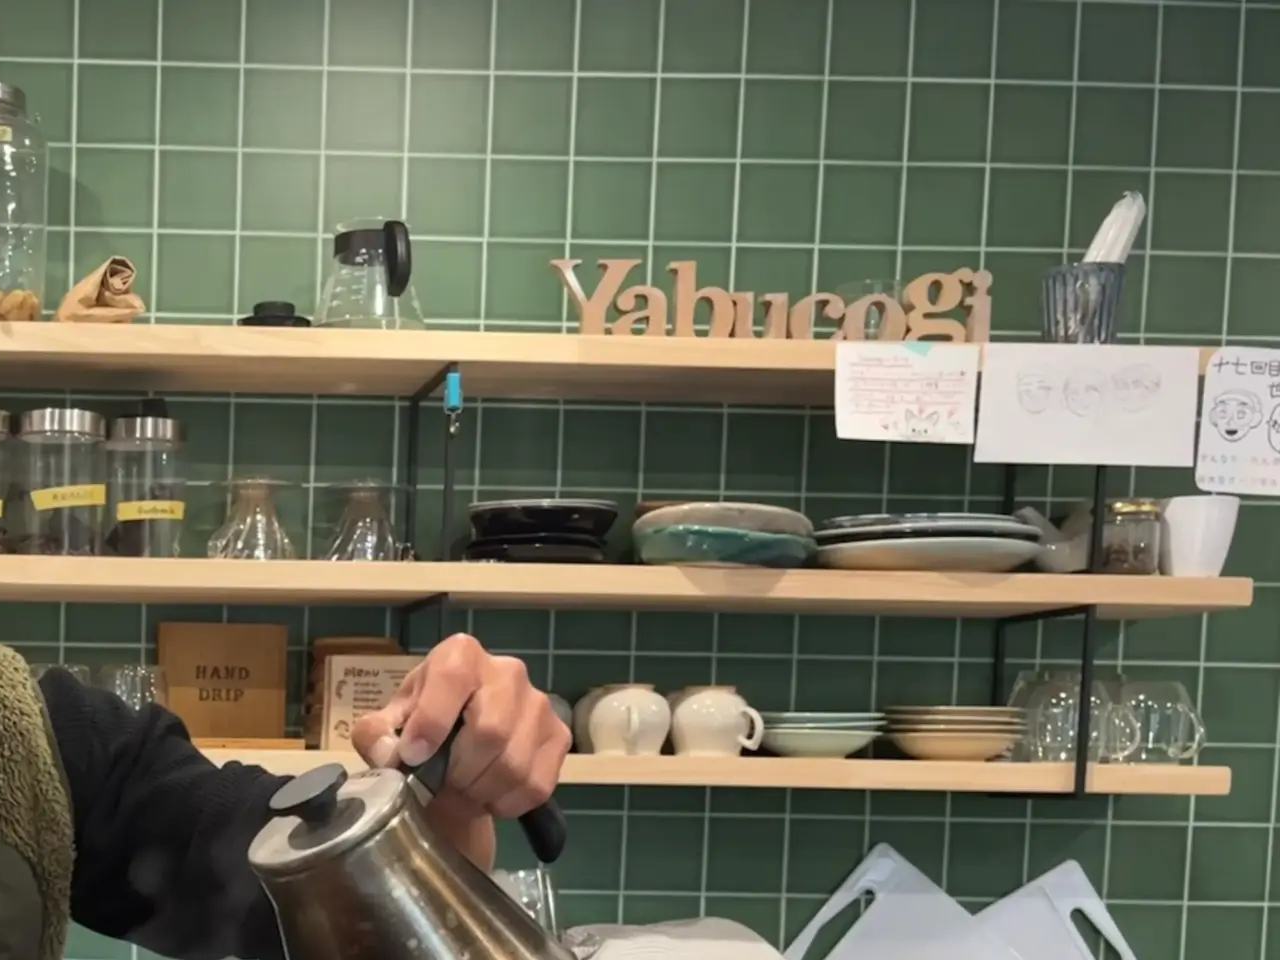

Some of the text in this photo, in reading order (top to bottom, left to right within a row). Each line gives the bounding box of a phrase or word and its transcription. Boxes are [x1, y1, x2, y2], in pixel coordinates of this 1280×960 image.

[549, 258, 994, 342] Yabucogi
[195, 665, 250, 680] HAND
[198, 688, 245, 702] DRIP
